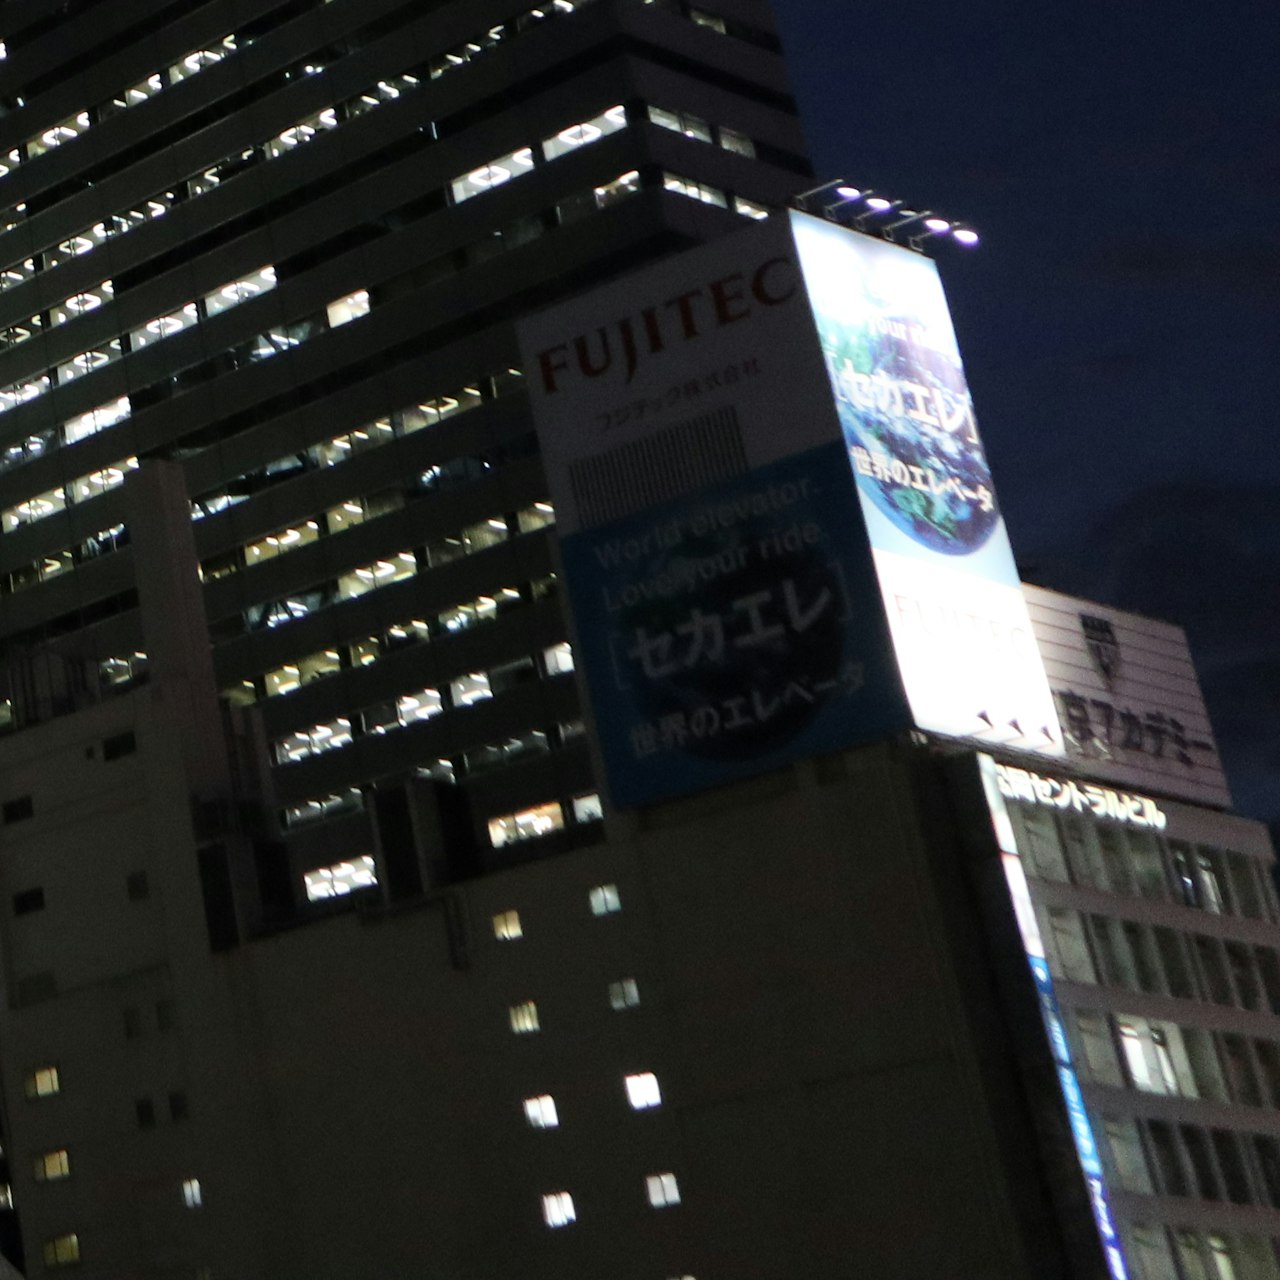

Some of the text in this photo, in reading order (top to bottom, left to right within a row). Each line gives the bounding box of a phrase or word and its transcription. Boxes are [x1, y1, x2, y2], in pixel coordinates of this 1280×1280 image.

[535, 255, 798, 395] FUJITEC
[593, 519, 683, 571] World
[1052, 688, 1214, 768] 京アカデミー
